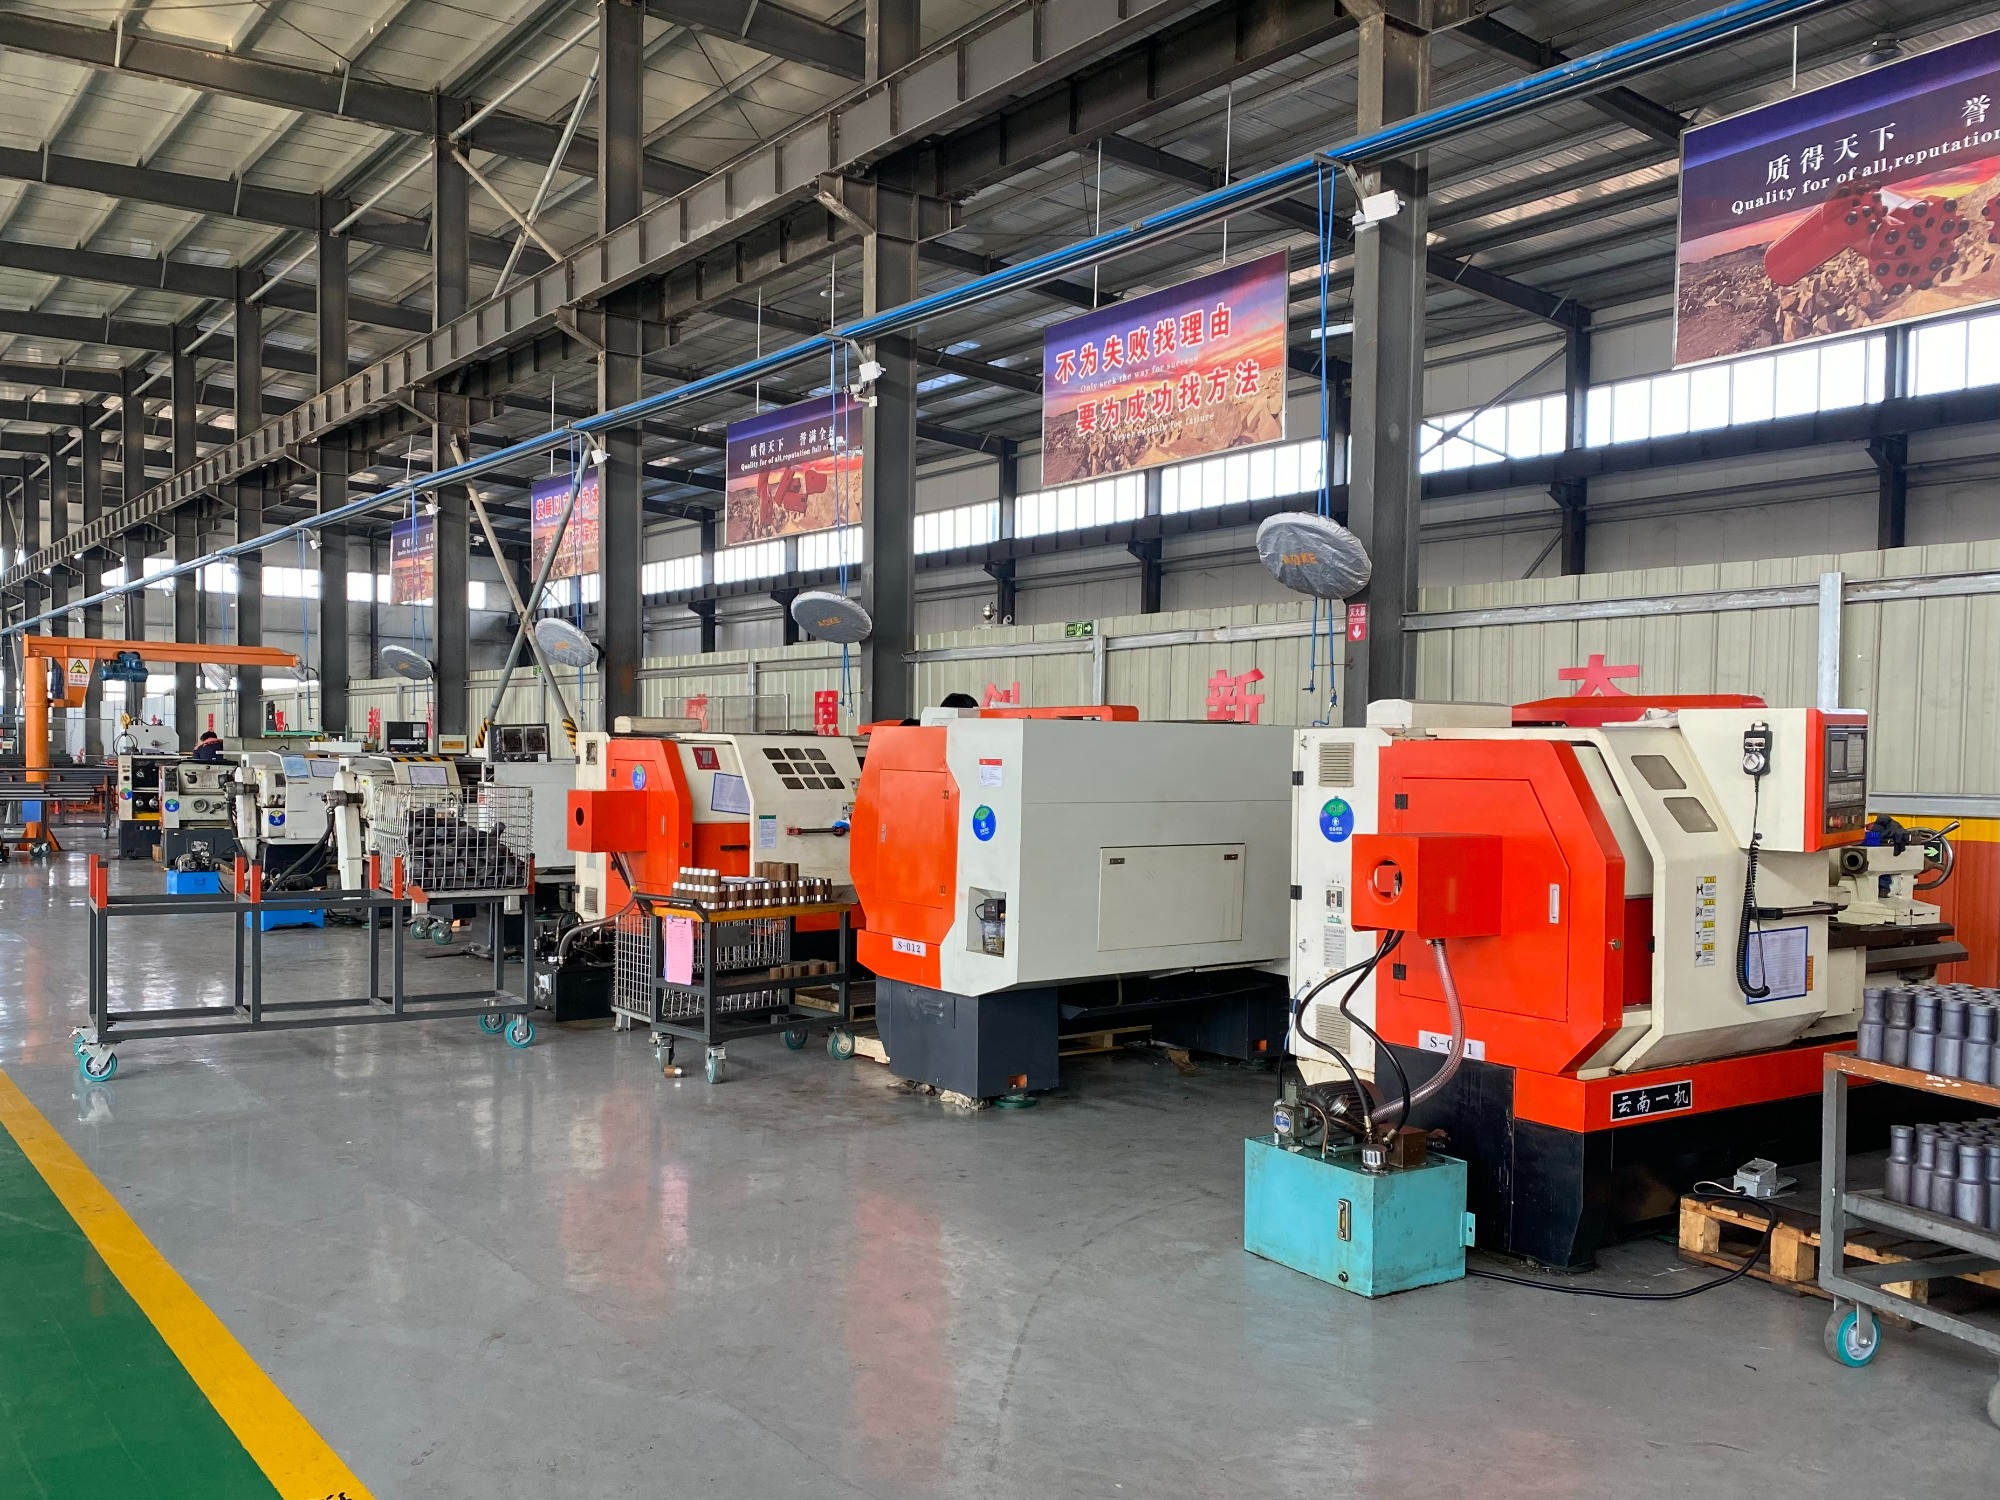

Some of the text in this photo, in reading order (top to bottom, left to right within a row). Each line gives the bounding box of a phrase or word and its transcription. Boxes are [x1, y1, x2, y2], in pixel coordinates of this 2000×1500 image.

[1765, 94, 1991, 186] 质得天下 誉
[1731, 186, 1796, 215] Quality
[1802, 177, 1830, 195] for
[1836, 166, 1857, 184] of
[1055, 301, 1232, 385] 不为失败找理由
[1080, 355, 1199, 393] Only seek the way for success
[1076, 358, 1261, 438] 要为成功找方法
[1170, 419, 1183, 429] for
[1185, 412, 1215, 426] failure
[740, 460, 758, 471] Quality
[768, 455, 774, 464] of
[1206, 668, 1264, 725] 新
[897, 940, 921, 953] S-012
[1430, 1036, 1472, 1055] S-01
[1618, 1085, 1689, 1113] 云南一机
